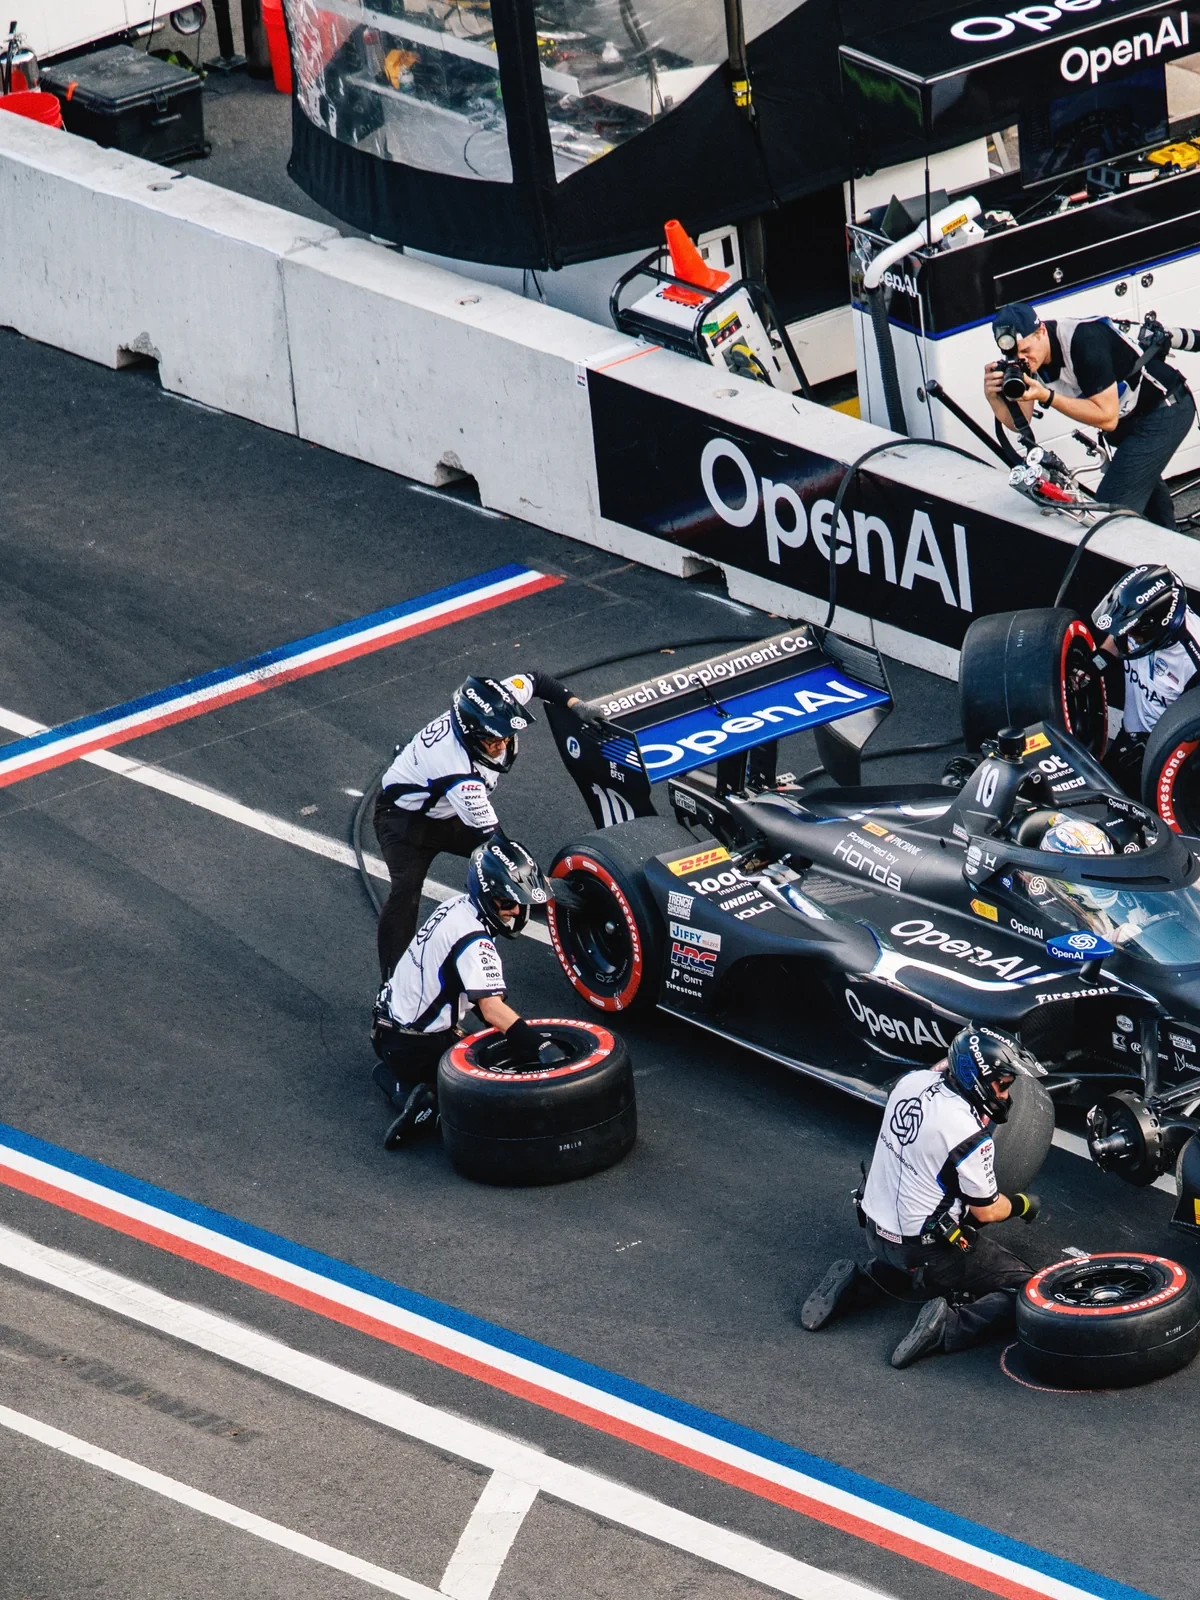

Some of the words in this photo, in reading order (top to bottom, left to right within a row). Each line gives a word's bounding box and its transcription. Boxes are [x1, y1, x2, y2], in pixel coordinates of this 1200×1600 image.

[1060, 11, 1190, 84] OpenAI
[701, 438, 973, 613] OpenAI
[1119, 565, 1148, 589] OpenAI
[1135, 579, 1166, 605] OpenAI
[1161, 587, 1180, 627] OpenAI
[600, 684, 658, 715] search
[659, 679, 675, 695] &
[674, 644, 782, 691] Deployment
[780, 635, 813, 653] Co.
[453, 695, 469, 735] OpenAI
[466, 688, 493, 714] OpenAI
[640, 680, 867, 769] OpenAI
[590, 782, 635, 828] 10
[975, 763, 1000, 808] 10
[1160, 750, 1186, 826] Firestone
[491, 845, 517, 871] OpenAI
[679, 851, 723, 872] DHL
[832, 840, 902, 892] Honda
[847, 831, 888, 858] Powered
[885, 851, 899, 865] by
[474, 852, 491, 893] OpenAI
[668, 893, 694, 908] TRENCH
[610, 882, 640, 963] Firestone
[1010, 918, 1044, 940] OpenAI
[547, 906, 577, 986] Firestone
[890, 919, 1041, 981] OpenAI
[1051, 946, 1084, 960] OpenAI
[665, 980, 702, 998] Firestone
[1035, 985, 1119, 1005] Firestone
[525, 1018, 595, 1030] irestone
[845, 988, 950, 1049] OpenAI
[980, 1027, 1014, 1048] OpenAI
[469, 1068, 551, 1081] Firestone
[969, 1035, 993, 1077] OpenAI
[1121, 1285, 1180, 1311] Firestone
